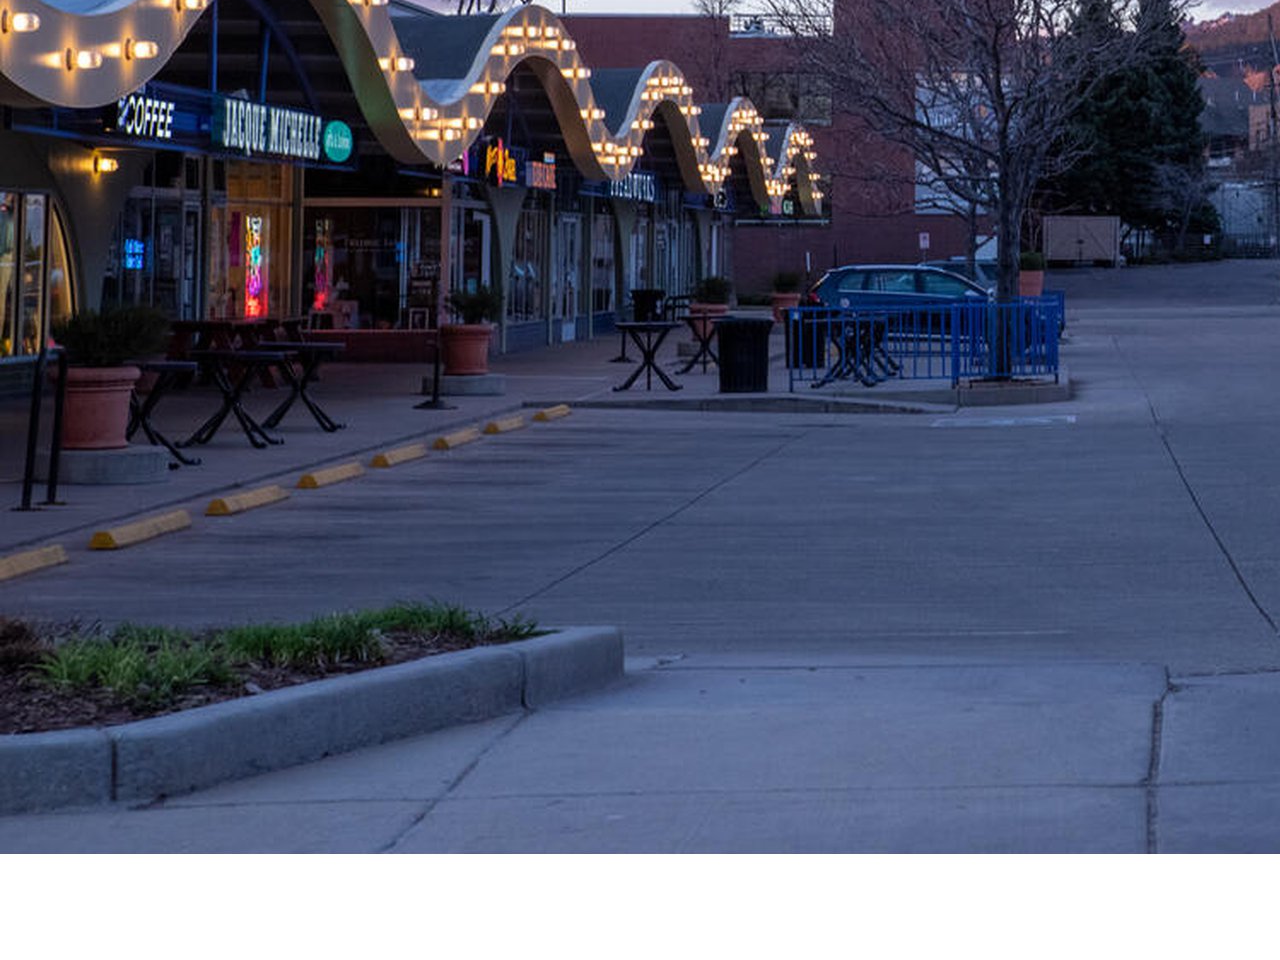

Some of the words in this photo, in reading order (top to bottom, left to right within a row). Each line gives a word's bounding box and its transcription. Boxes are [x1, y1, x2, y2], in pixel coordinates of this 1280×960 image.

[126, 95, 176, 138] COFFEE
[223, 99, 266, 156] JACQUE
[269, 108, 322, 160] MICHELLE
